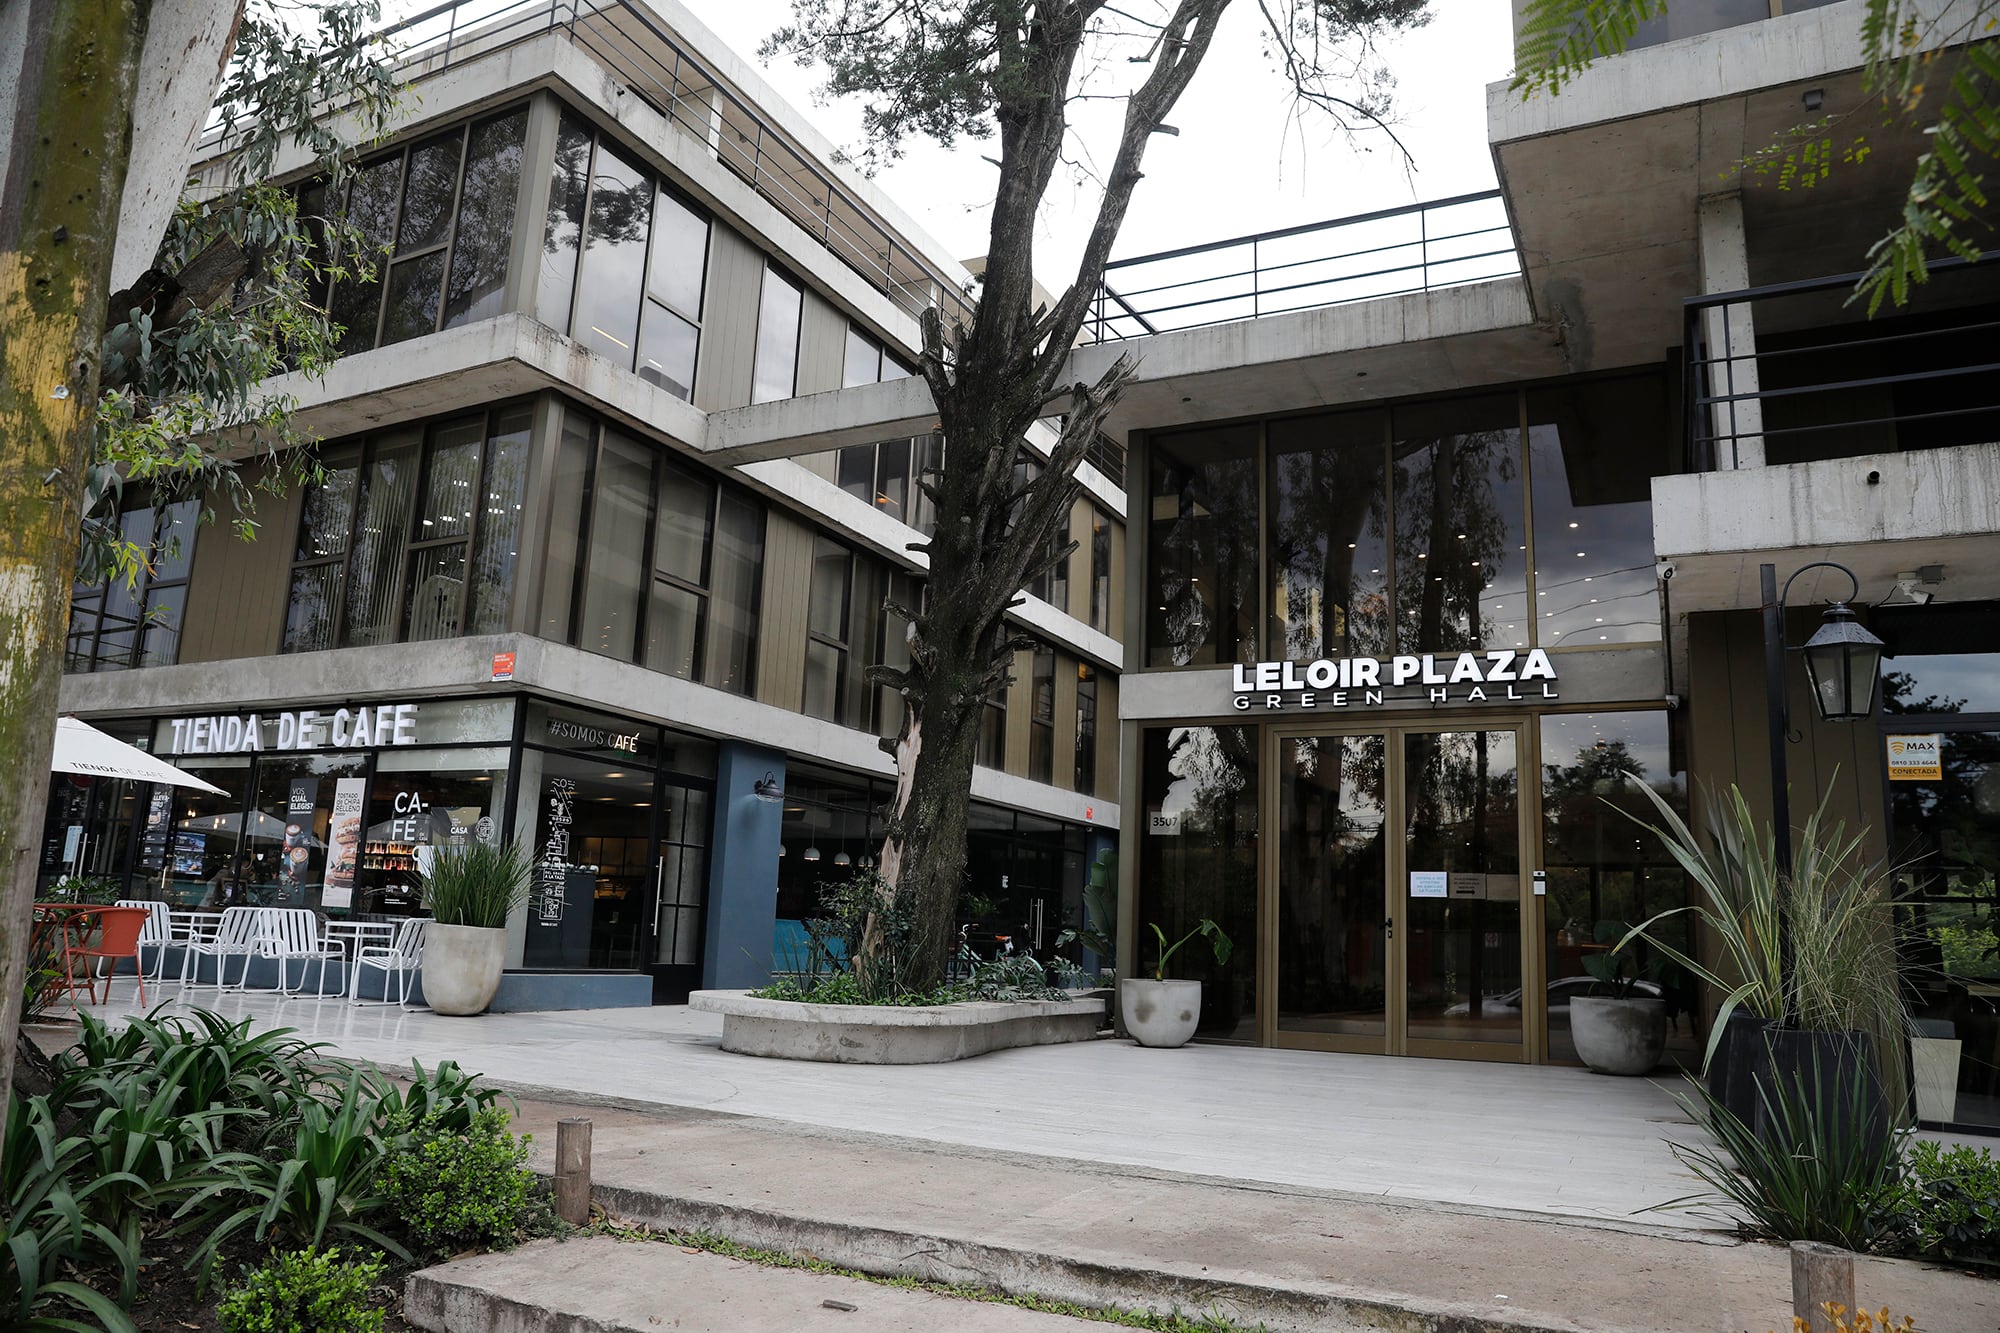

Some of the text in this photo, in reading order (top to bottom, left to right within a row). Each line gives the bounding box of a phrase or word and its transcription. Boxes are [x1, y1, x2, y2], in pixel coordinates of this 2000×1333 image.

[1232, 648, 1559, 693] LELOIR PLAZA
[1232, 682, 1559, 710] GREEN HALL
[171, 704, 419, 754] TIENDA DE CAFE
[551, 721, 640, 753] #SOMOS CAFÉ
[1906, 742, 1935, 750] MAX
[70, 762, 119, 774] TIENDA
[292, 787, 305, 795] VOS
[394, 791, 429, 813] CA-
[392, 815, 416, 841] FÉ
[450, 826, 468, 835] CASA
[1152, 816, 1178, 827] 3507
